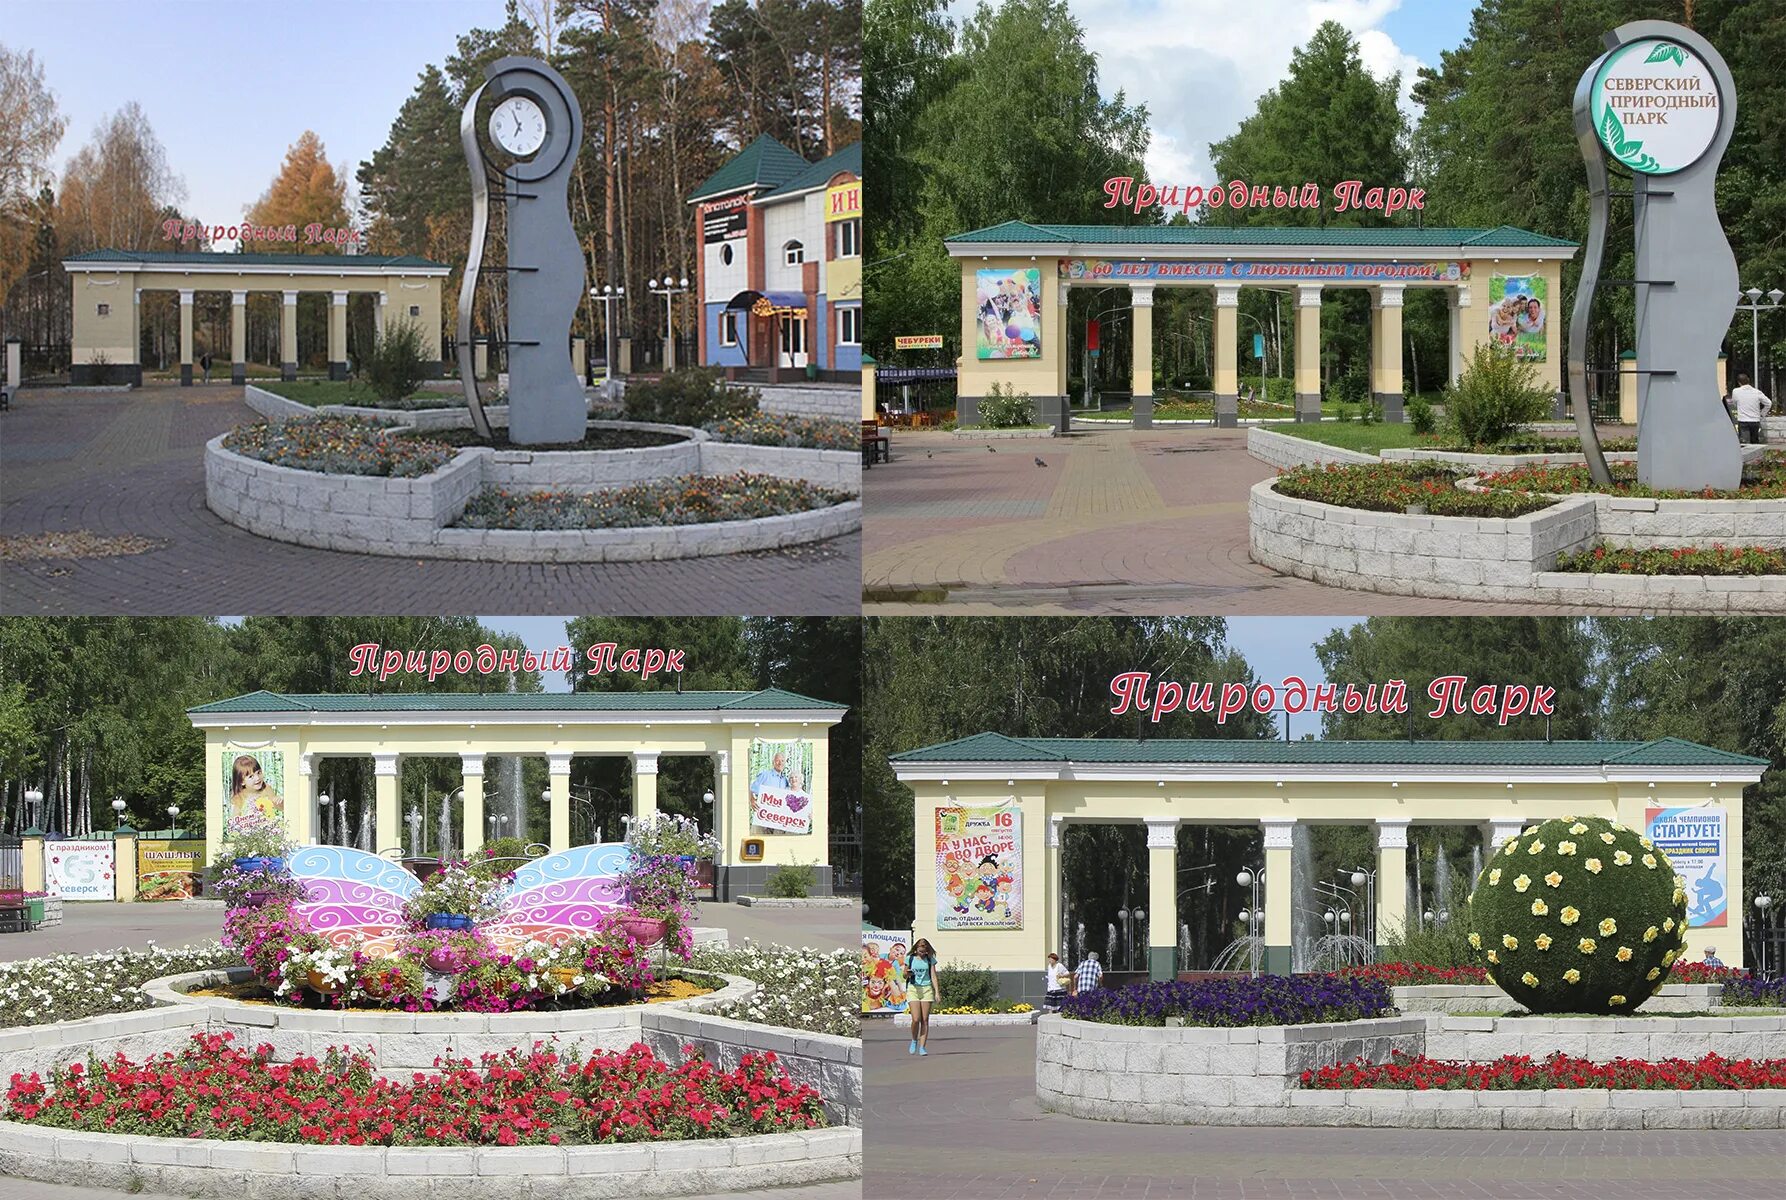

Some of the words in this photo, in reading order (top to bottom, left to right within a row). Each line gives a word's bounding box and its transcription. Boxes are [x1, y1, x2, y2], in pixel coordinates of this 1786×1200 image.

[1605, 75, 1701, 91] СЕВЕРСКИЙ
[1610, 92, 1717, 110] ПРИРОДНЫЙ
[1623, 112, 1668, 125] ПАРК
[1103, 176, 1320, 215] Природный
[1334, 180, 1426, 217] Парк
[163, 218, 297, 244] Природный
[305, 223, 361, 247] Парк
[1092, 263, 1113, 275] 60
[1117, 263, 1153, 276] ЛЕТ
[1157, 263, 1225, 276] ВМЕСТЕ
[1231, 263, 1243, 276] С
[1247, 263, 1347, 276] ЛЮБИМЫМ
[1352, 263, 1438, 278] ГОРОДОМ!
[349, 643, 573, 682] Природный
[586, 642, 686, 681] Парк
[1110, 672, 1409, 724] Природный
[1428, 676, 1556, 726] Парк
[762, 793, 783, 807] Мы
[759, 808, 807, 827] Северск
[994, 813, 1013, 827] 16
[1653, 824, 1720, 838] СТАРТУЕТ!
[56, 844, 110, 852] праздником!
[941, 842, 949, 851] А
[952, 841, 960, 850] У
[954, 849, 971, 860] ВО
[975, 841, 1015, 859] ДВОРЕ
[144, 851, 202, 859] ШАШЛЫК
[60, 886, 98, 894] северск
[868, 933, 906, 943] ПЛОЩАДКА
